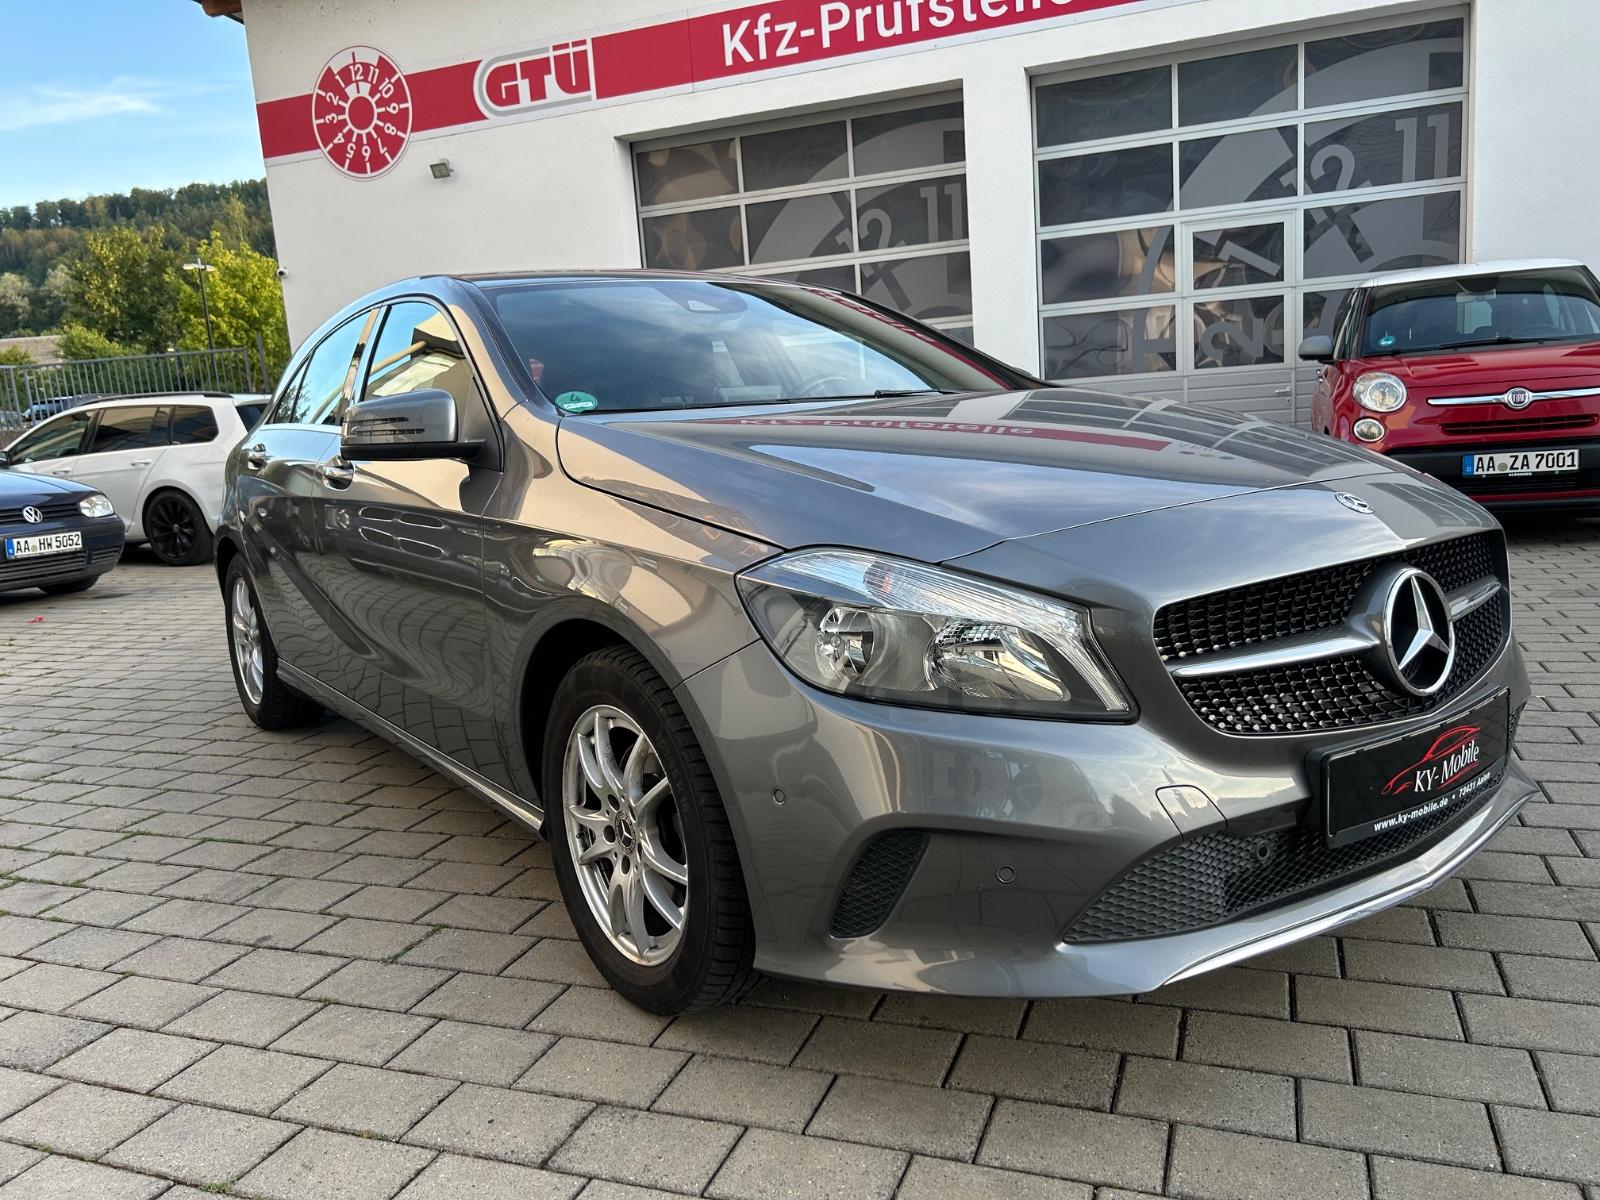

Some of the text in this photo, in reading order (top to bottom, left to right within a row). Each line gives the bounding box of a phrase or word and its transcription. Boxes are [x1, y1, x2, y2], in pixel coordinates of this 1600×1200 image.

[349, 64, 364, 81] 12
[368, 66, 380, 84] 11
[486, 39, 591, 107] GTÜ
[379, 77, 394, 99] 10
[326, 92, 340, 106] 2
[325, 113, 338, 124] 3
[384, 123, 397, 136] 8
[333, 133, 345, 144] 4
[377, 137, 388, 155] 7
[346, 142, 356, 159] 5
[1476, 456, 1496, 472] AA
[1509, 454, 1530, 471] ZA
[1535, 452, 1576, 469] 7001
[16, 540, 31, 554] AA
[39, 537, 53, 551] HW
[55, 533, 81, 549] 5052
